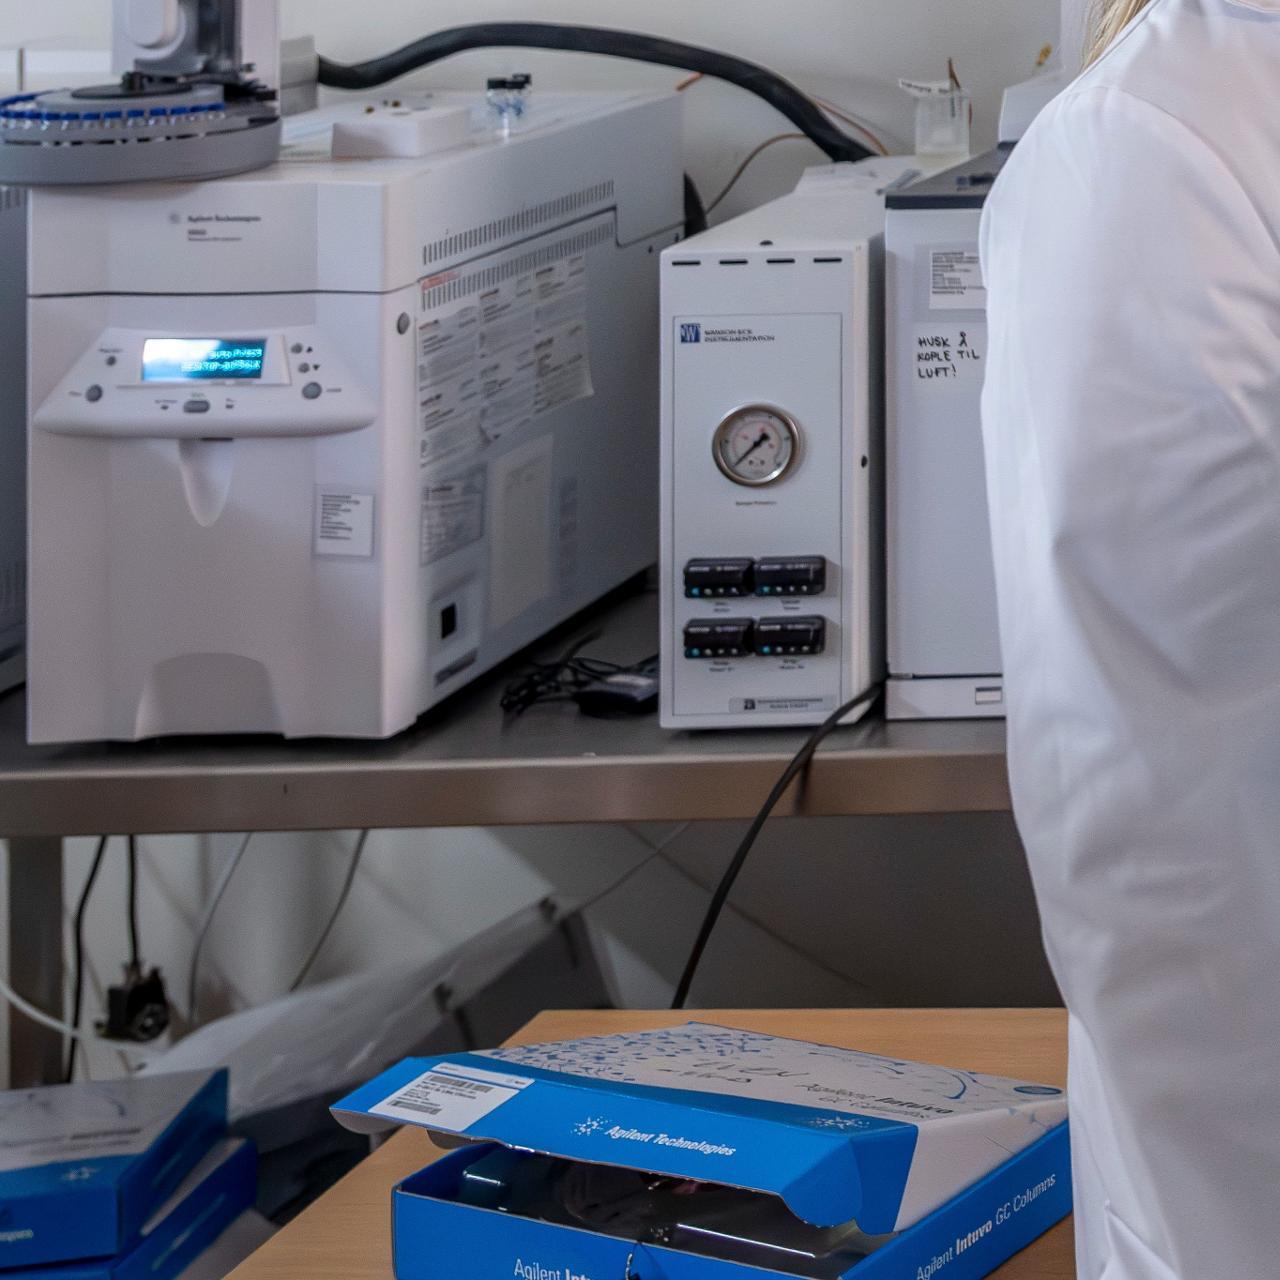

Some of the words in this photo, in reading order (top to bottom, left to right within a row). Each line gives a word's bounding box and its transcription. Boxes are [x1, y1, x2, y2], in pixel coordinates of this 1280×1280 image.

[918, 336, 951, 348] HUSK
[959, 331, 968, 347] Å
[917, 350, 951, 361] KOPLE
[957, 349, 980, 359] TIL
[918, 363, 956, 378] LUFT!
[874, 1096, 954, 1115] Intuvo
[604, 1125, 654, 1143] Agilent
[652, 1133, 737, 1156] Technologies
[916, 1247, 954, 1280] Agilent
[955, 1219, 993, 1256] Intuvo
[995, 1201, 1012, 1225] GC
[1012, 1173, 1056, 1213] Columns
